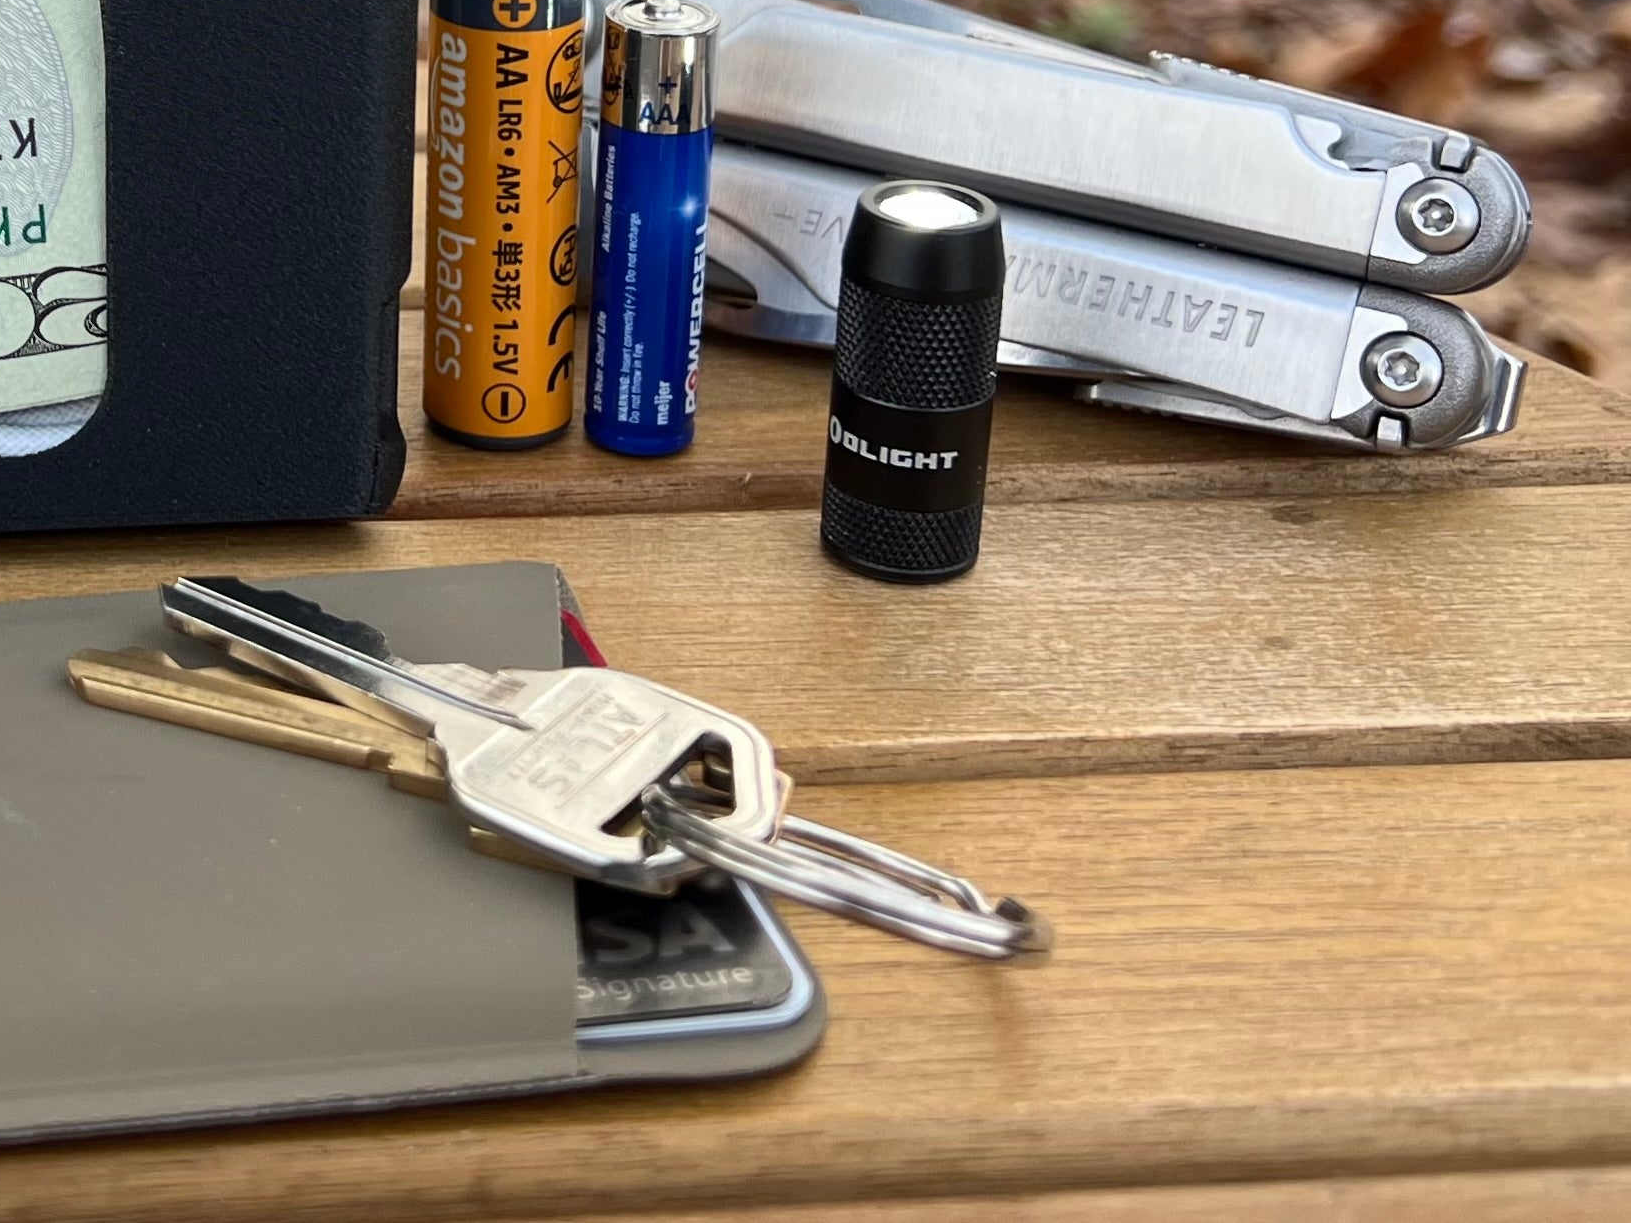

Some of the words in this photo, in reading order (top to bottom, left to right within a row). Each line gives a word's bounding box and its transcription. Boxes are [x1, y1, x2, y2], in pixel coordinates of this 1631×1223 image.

[496, 43, 529, 89] AA
[436, 32, 468, 220] amazon
[497, 99, 522, 142] LR6
[638, 100, 690, 126] AAA
[496, 163, 521, 214] AM3
[604, 144, 616, 201] Batteries
[601, 203, 612, 253] Alkaline
[434, 227, 477, 380] basics
[596, 310, 607, 334] Life
[492, 320, 519, 376] 1.5V
[595, 334, 605, 368] Shelf
[623, 310, 636, 348] correctly
[620, 348, 632, 373] Insert
[629, 410, 641, 424] Do
[654, 380, 673, 426] meijer
[577, 966, 755, 1001] Signature
